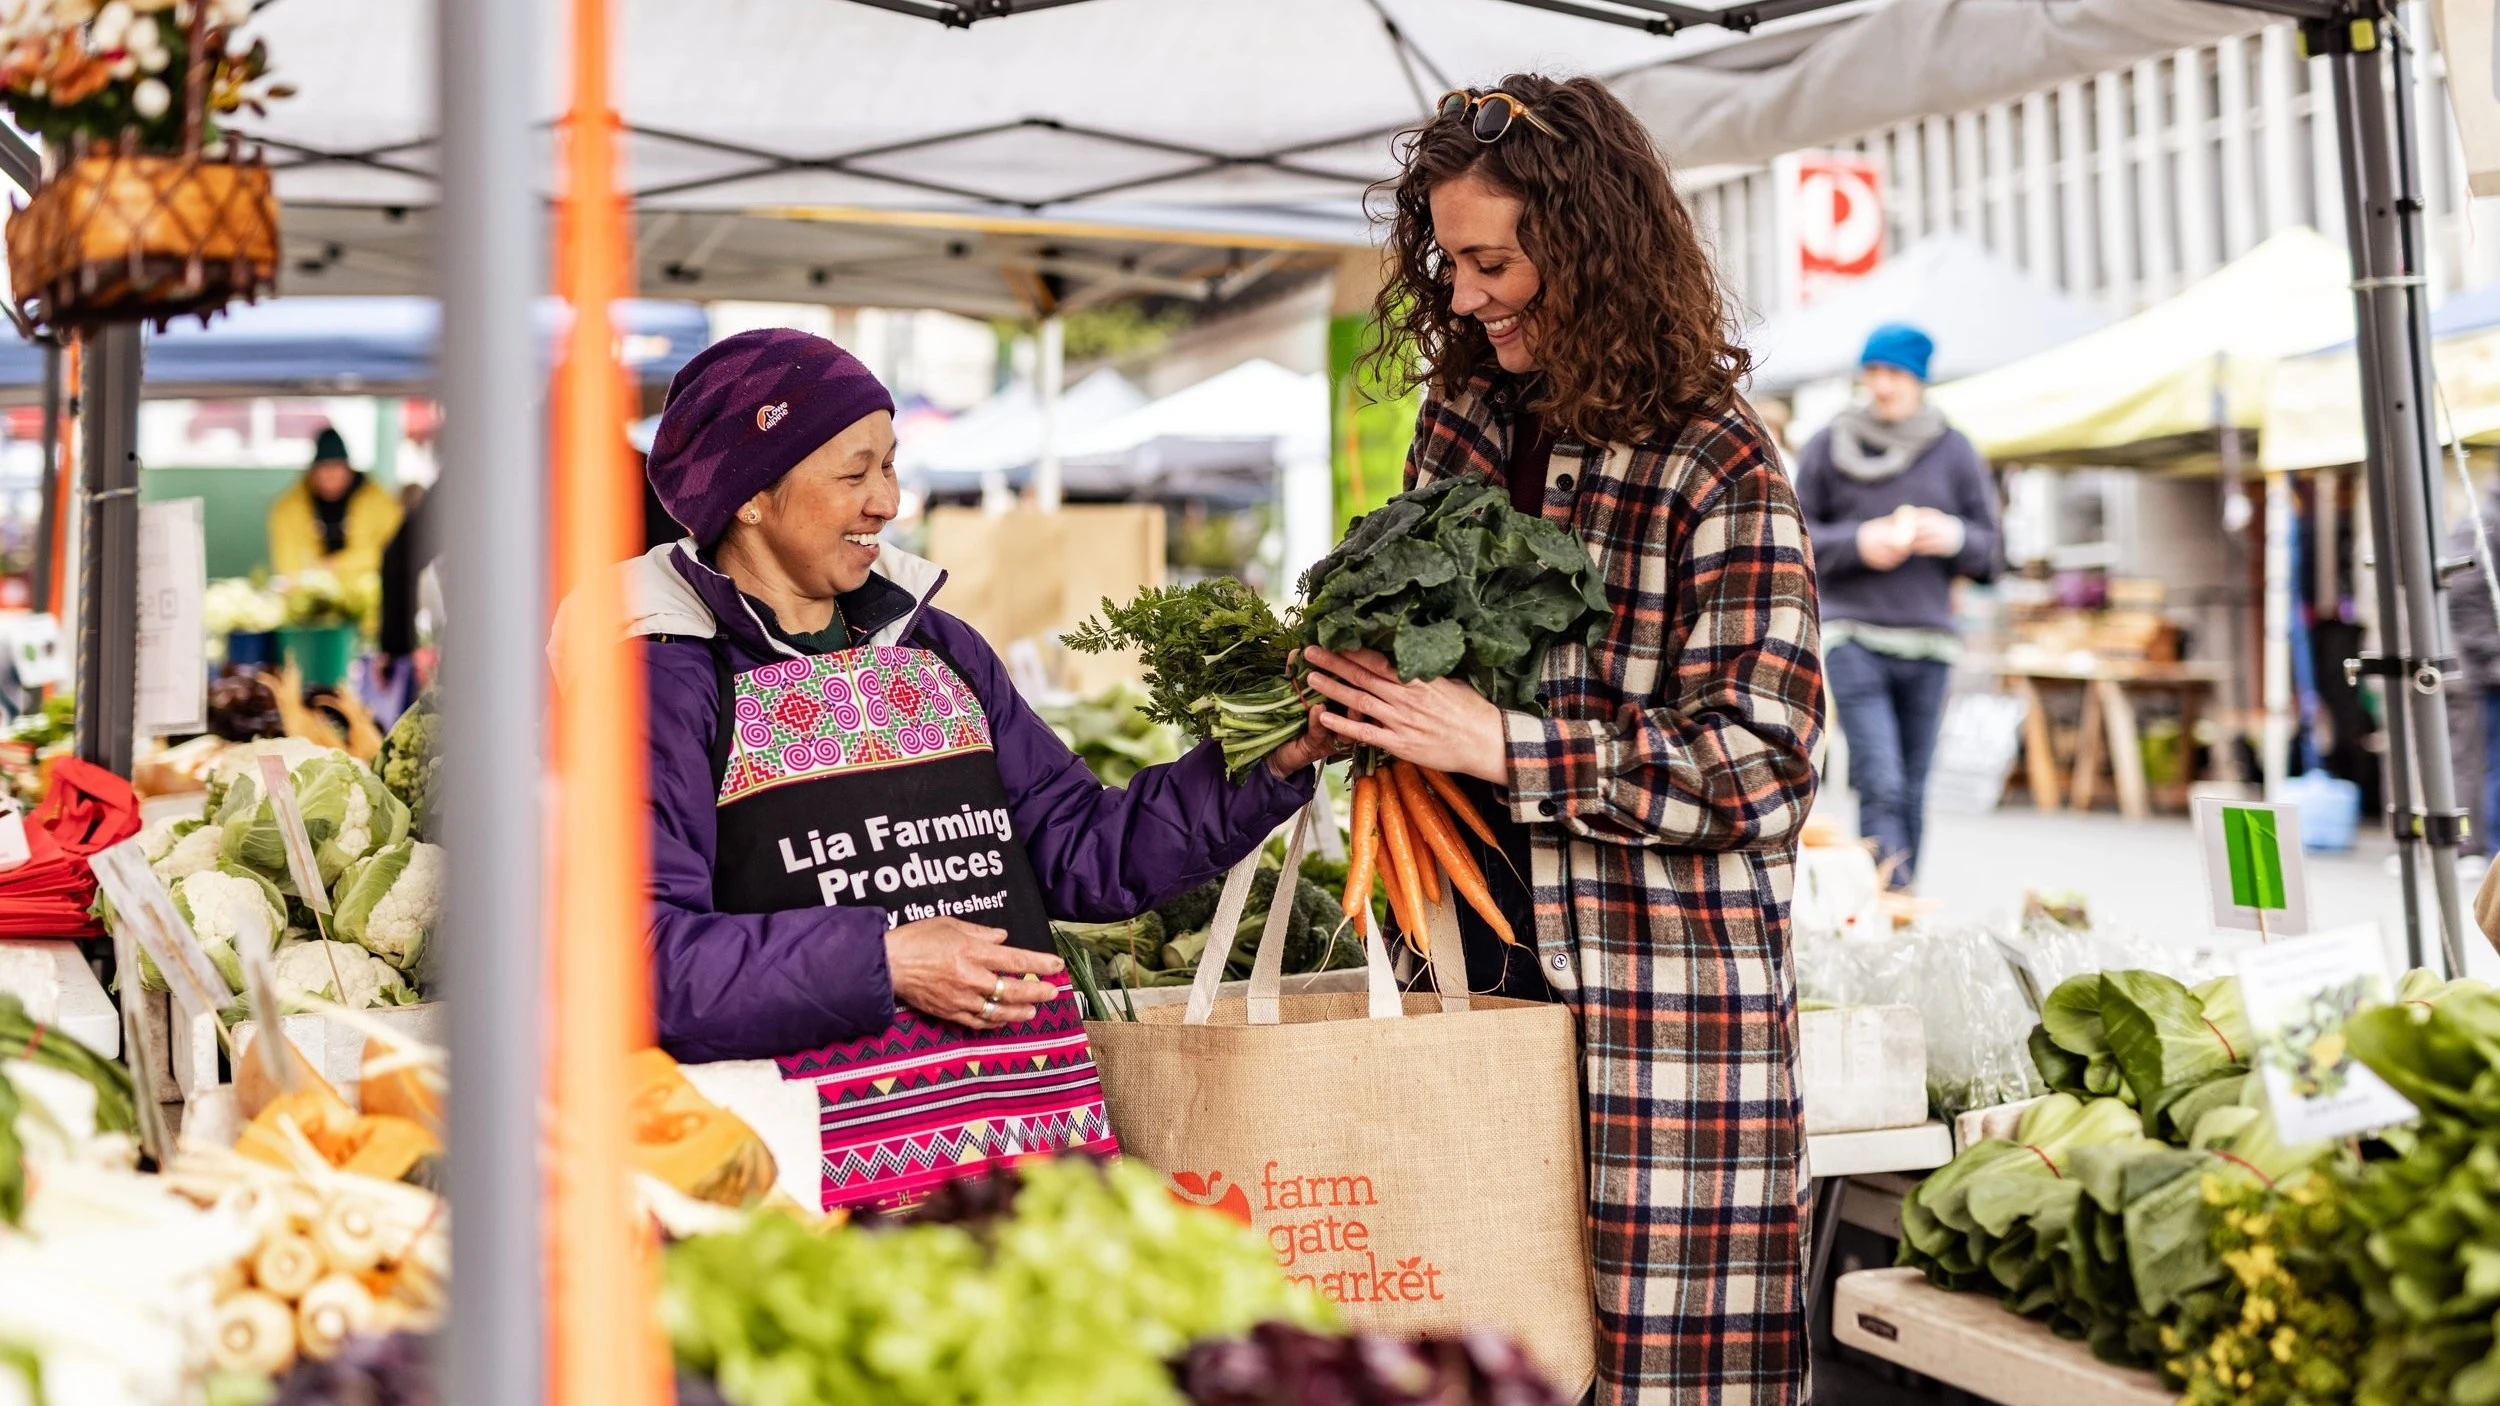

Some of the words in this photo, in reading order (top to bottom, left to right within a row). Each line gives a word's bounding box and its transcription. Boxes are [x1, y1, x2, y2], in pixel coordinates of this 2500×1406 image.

[777, 829, 856, 873] Lia
[864, 804, 1013, 852] Farming
[817, 849, 1004, 906] Produces
[904, 903, 935, 922] the
[1261, 1160, 1378, 1211] farm
[1267, 1215, 1370, 1267] gate
